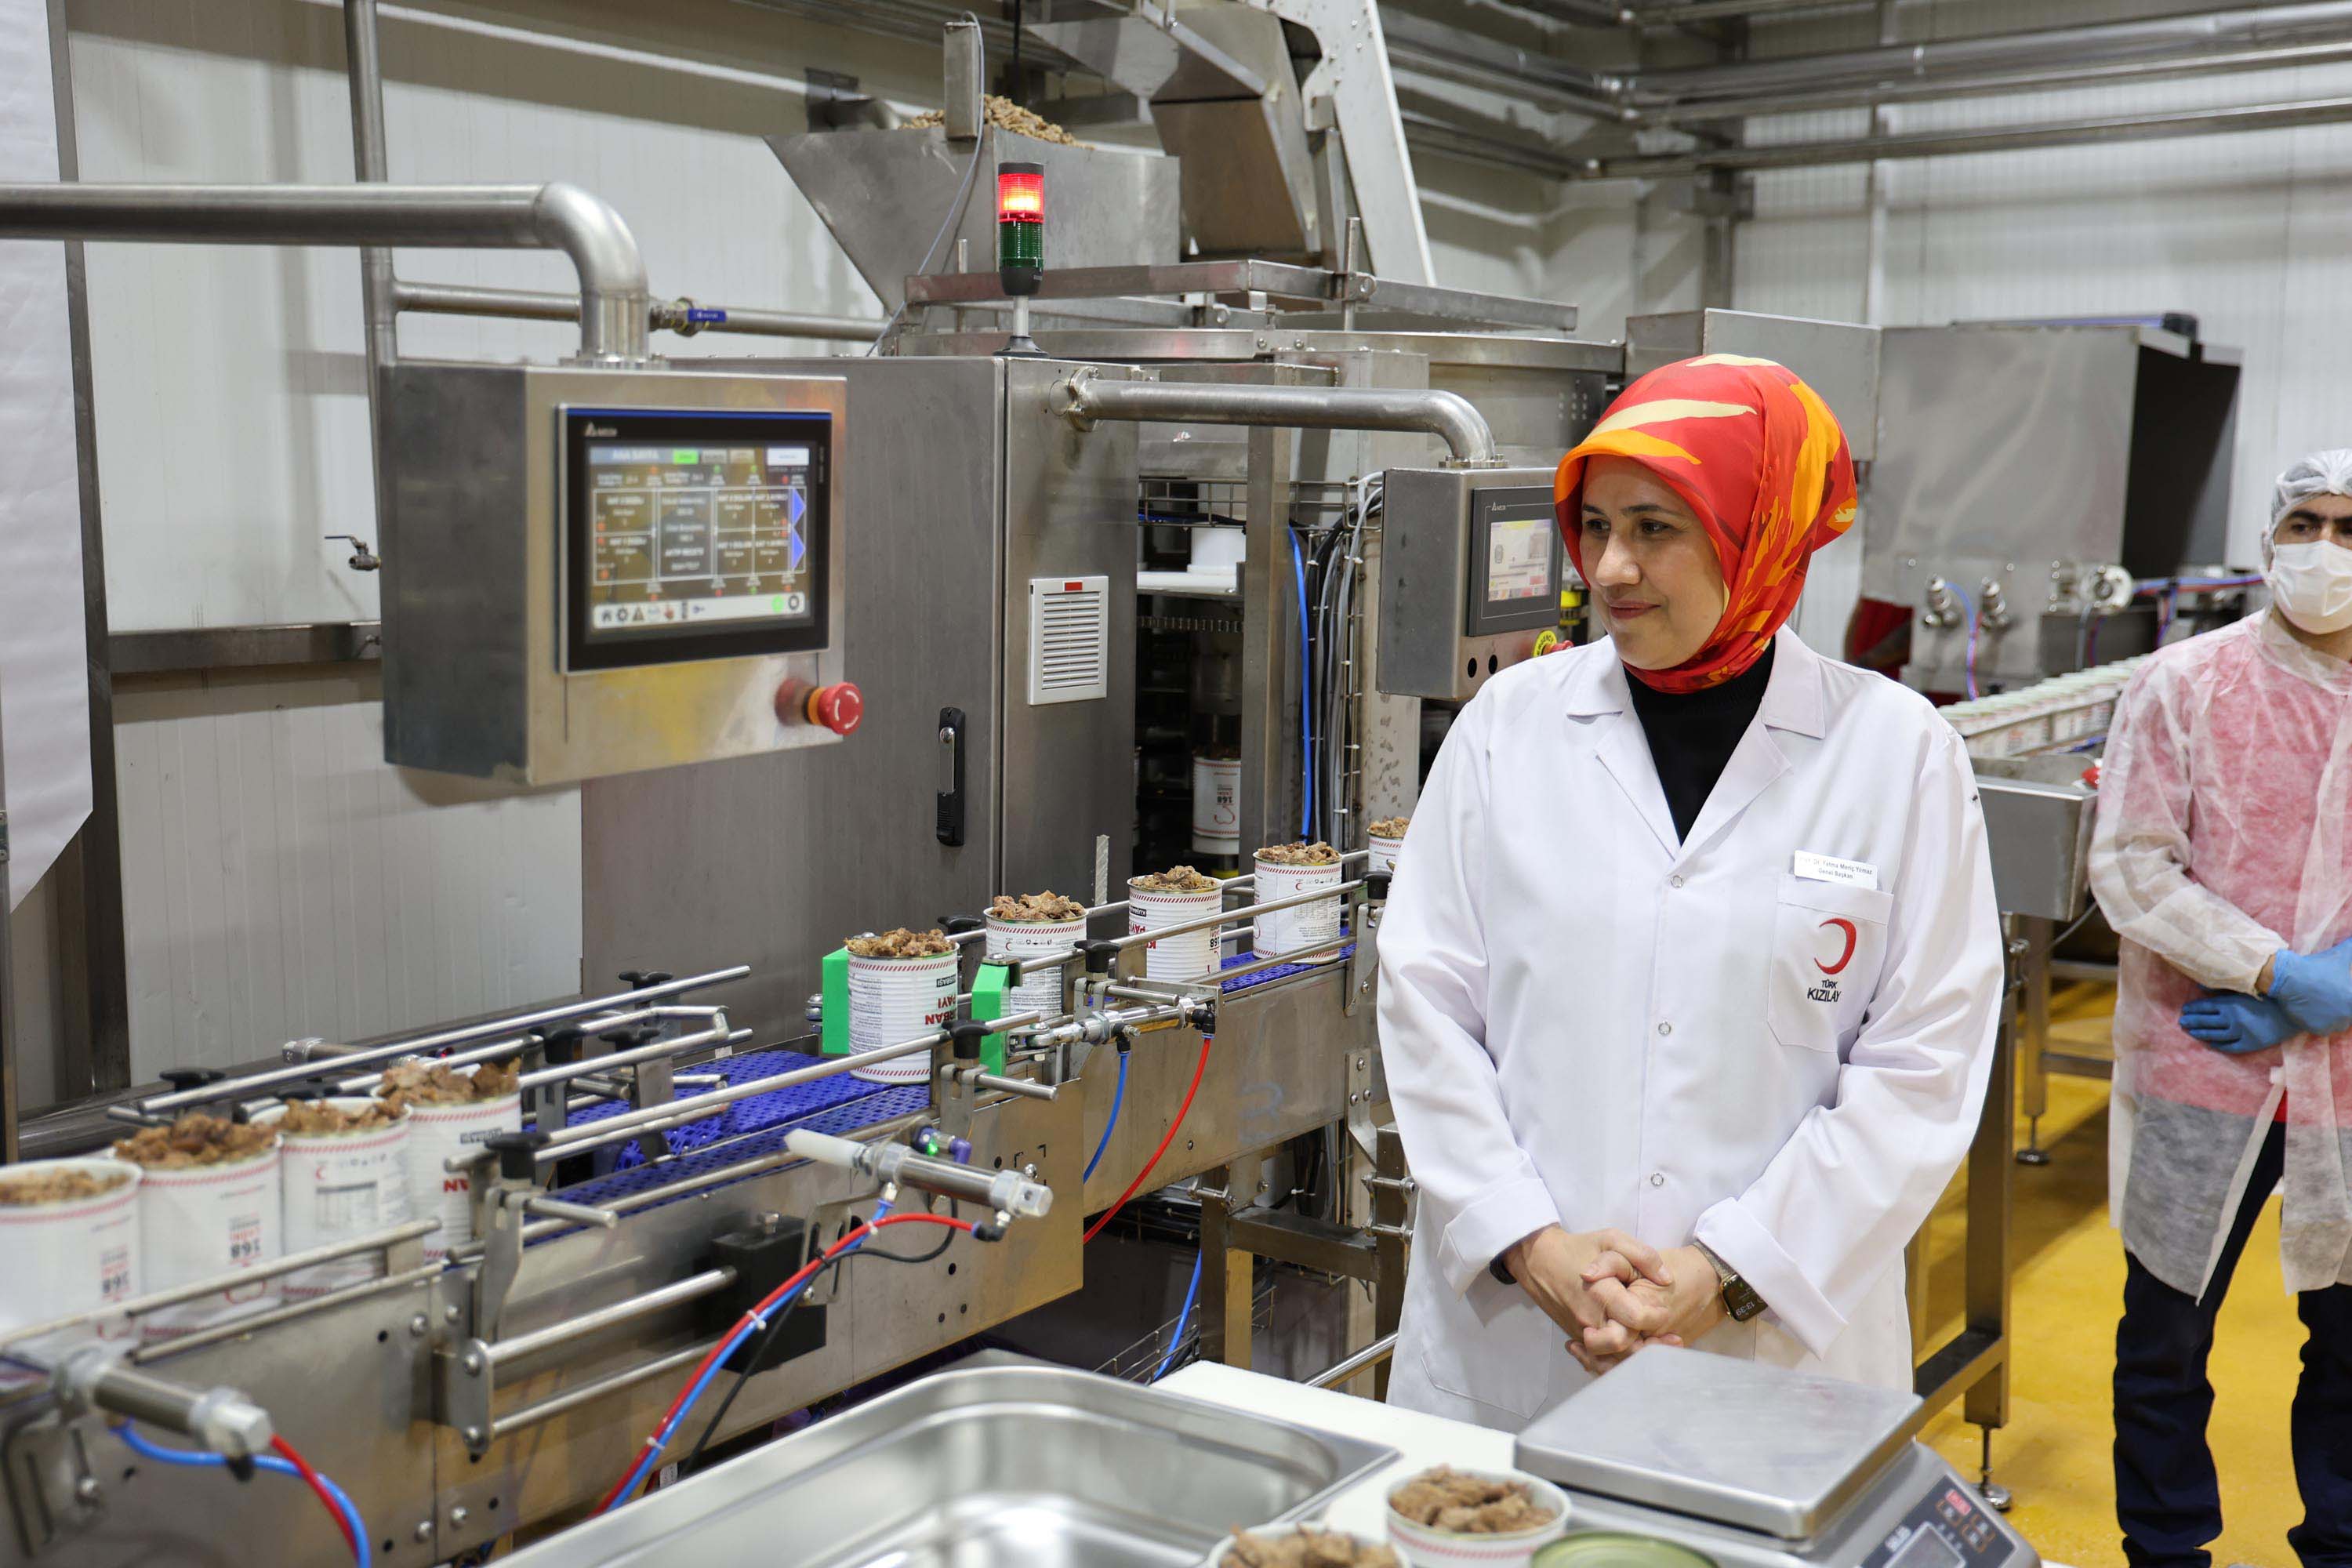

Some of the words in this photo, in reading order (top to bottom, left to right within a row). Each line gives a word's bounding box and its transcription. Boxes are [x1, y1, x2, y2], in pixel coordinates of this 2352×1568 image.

[1839, 863, 1855, 873] Meriç
[1821, 978, 1838, 989] TÜRK
[1807, 987, 1842, 1003] KIZILAY
[1736, 1301, 1755, 1316] 13:39
